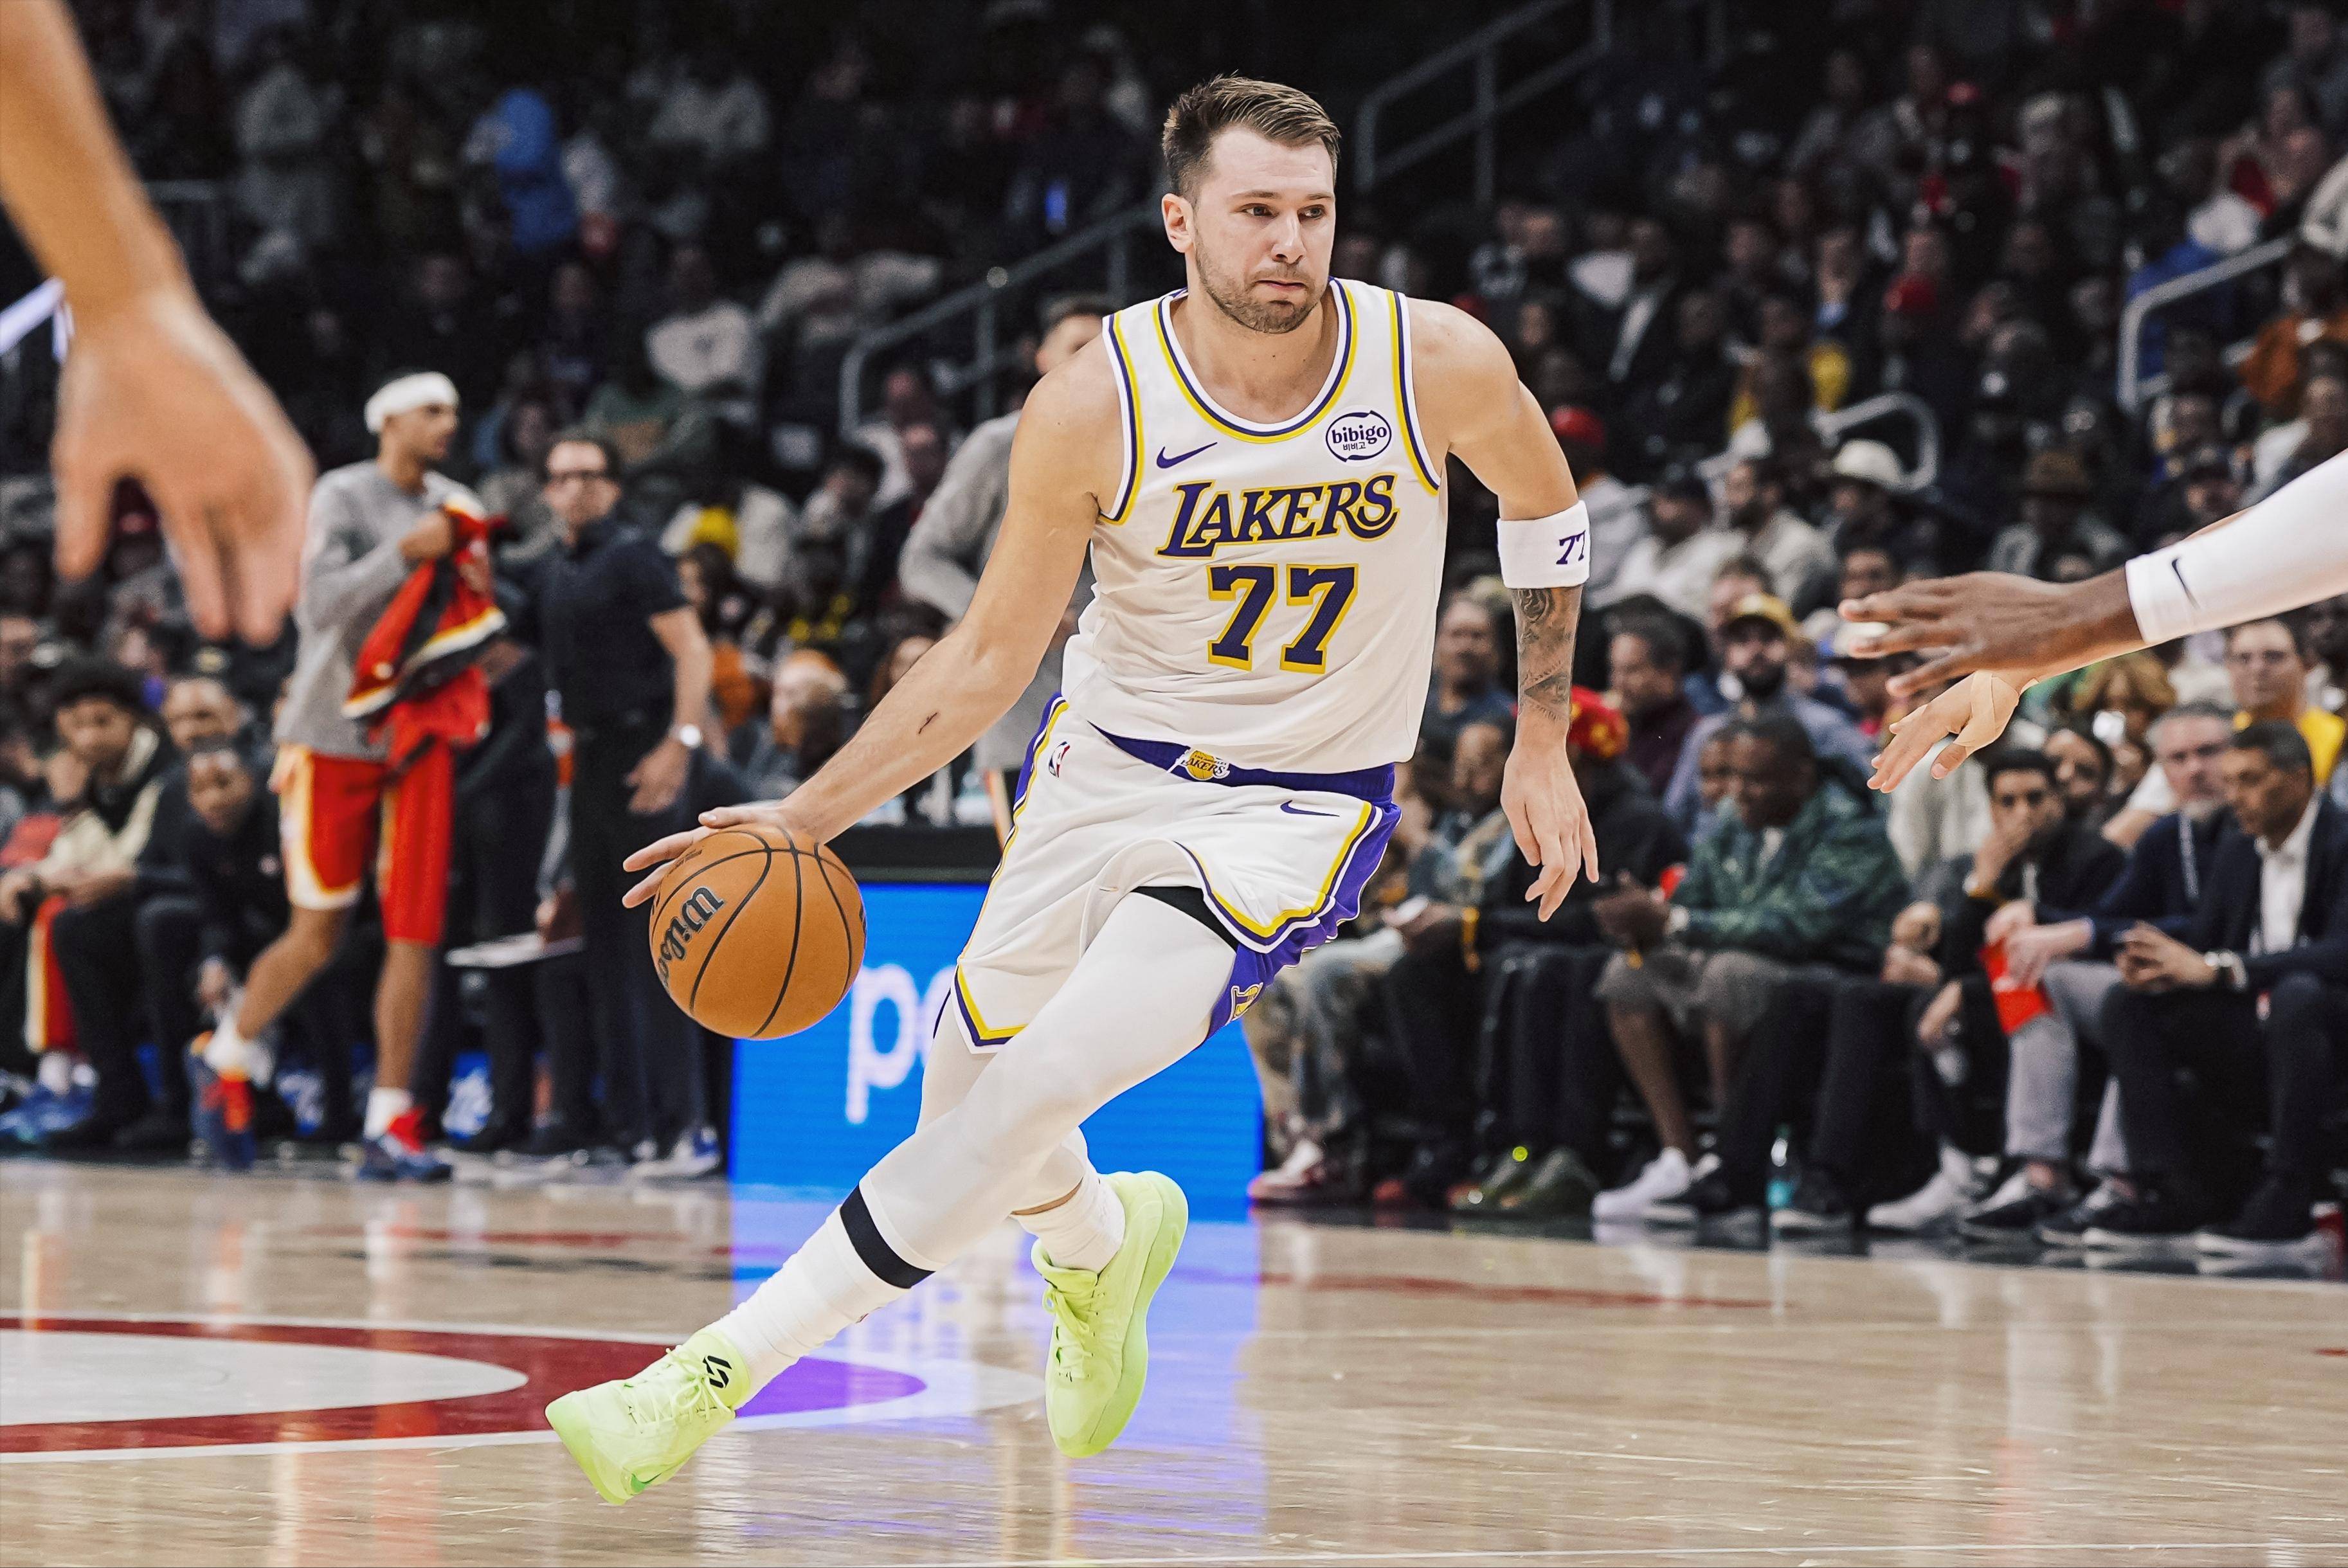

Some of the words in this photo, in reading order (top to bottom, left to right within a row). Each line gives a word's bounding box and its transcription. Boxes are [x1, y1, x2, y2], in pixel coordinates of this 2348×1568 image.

[1332, 425, 1387, 444] bibigo
[1342, 442, 1366, 451] 비비고
[1154, 473, 1400, 560] LAKERS
[1556, 530, 1585, 564] 77
[1206, 563, 1359, 674] 77
[658, 887, 725, 989] Wilso
